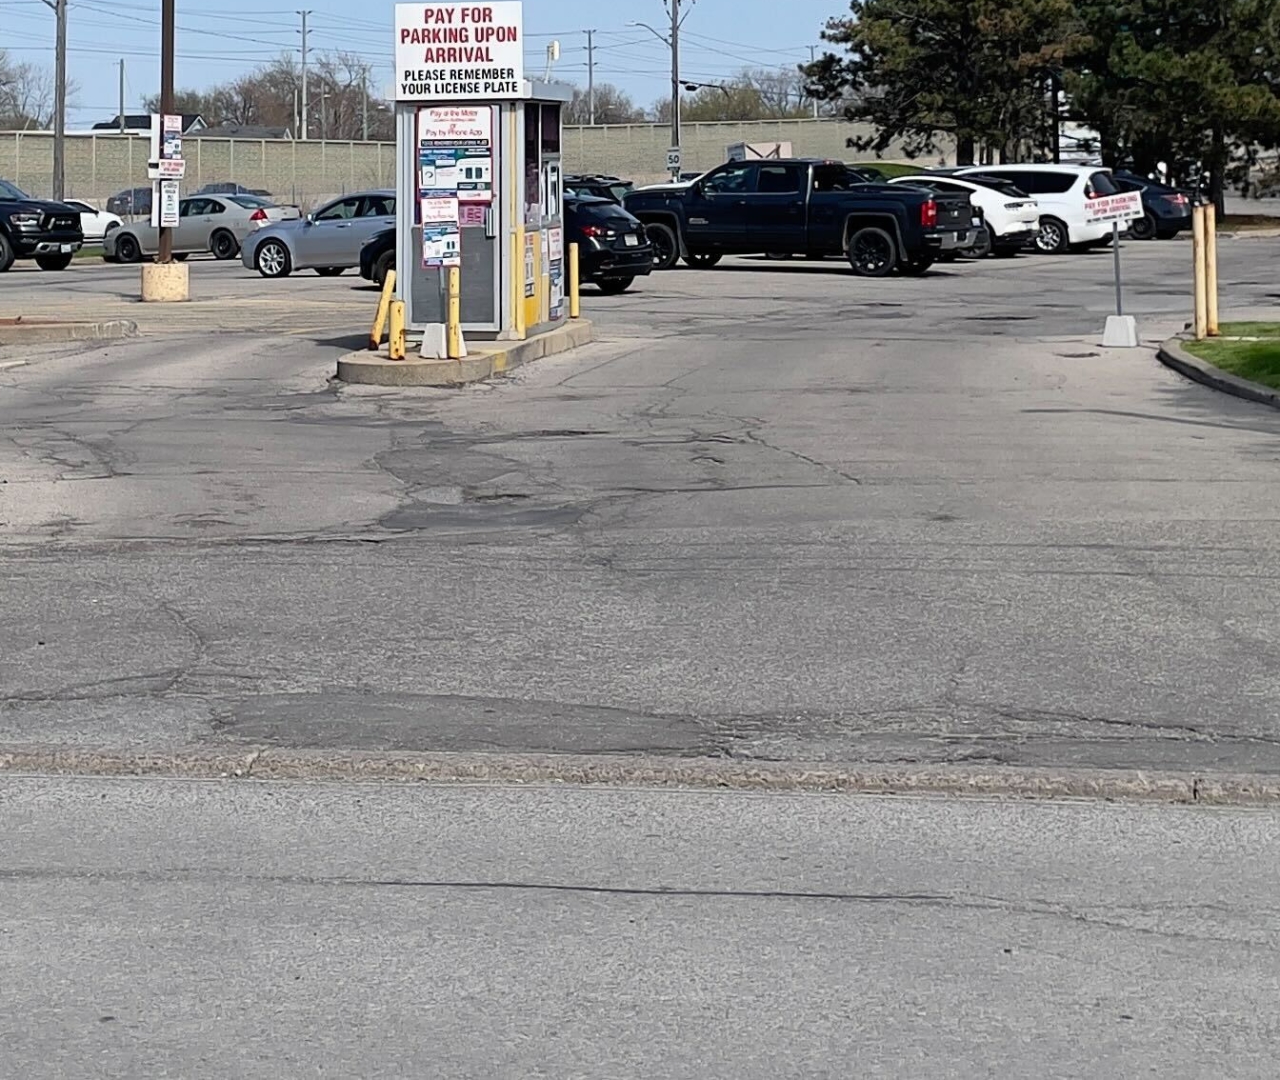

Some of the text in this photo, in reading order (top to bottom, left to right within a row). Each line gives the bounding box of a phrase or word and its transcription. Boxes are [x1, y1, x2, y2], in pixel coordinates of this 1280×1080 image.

[424, 7, 492, 24] PAY FOR
[401, 26, 517, 44] PARKING UPON
[424, 46, 494, 63] ARRIVAL
[404, 68, 514, 81] PLEASE REMEMBER
[401, 81, 518, 94] YOUR LICENSE PLATE
[668, 154, 680, 164] 50
